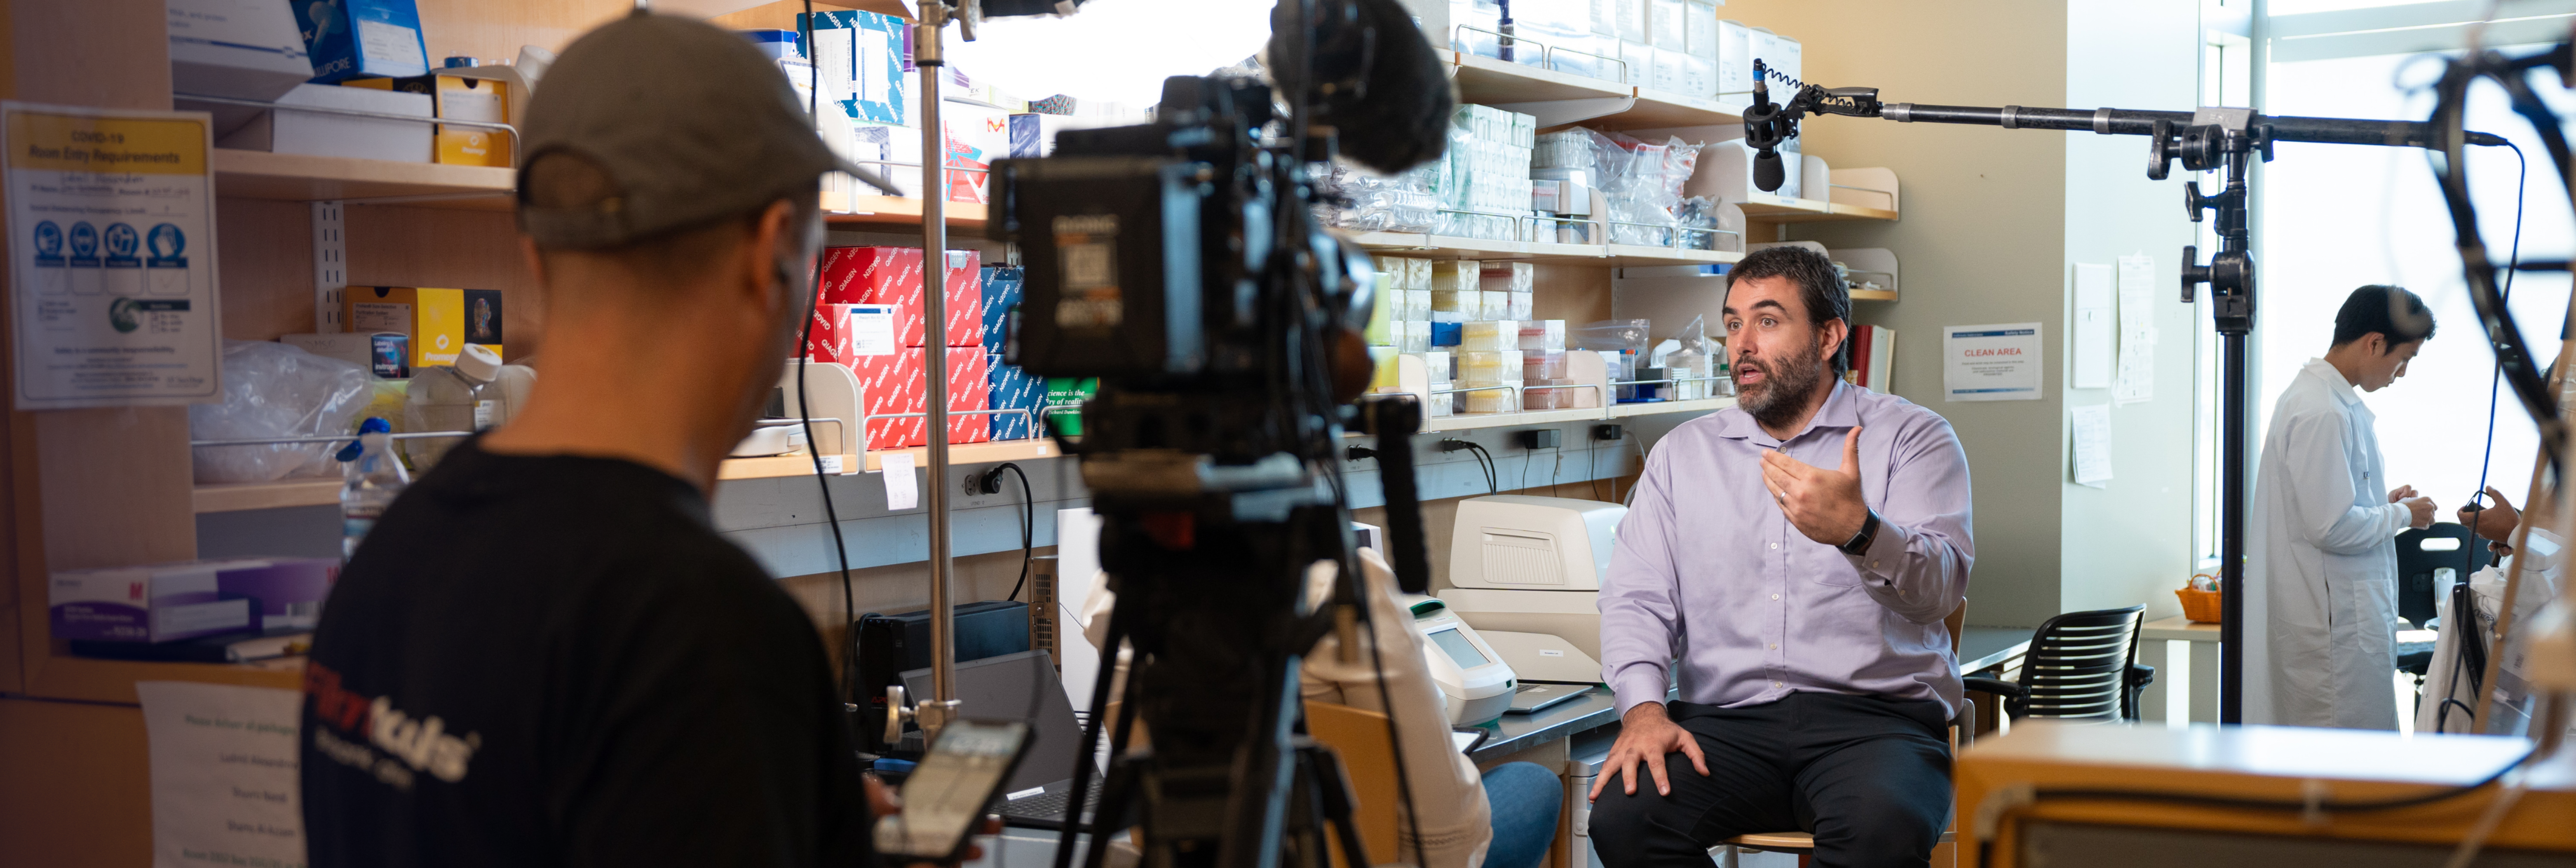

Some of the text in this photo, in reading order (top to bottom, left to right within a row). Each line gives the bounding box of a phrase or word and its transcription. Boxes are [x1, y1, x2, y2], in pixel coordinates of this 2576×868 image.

[825, 12, 843, 29] IAGEN
[882, 15, 896, 40] QIAGEN
[888, 47, 902, 72] QIAGEN
[71, 130, 124, 143] COVID-19
[29, 144, 180, 165] Room Entry Requirements
[823, 249, 841, 272] QIAGEN
[863, 256, 881, 279] QIAGEN
[839, 268, 857, 291] QIAGEN
[897, 264, 911, 286] QIAGEN
[878, 275, 893, 298] QIAGEN
[908, 283, 922, 306] QIAGEN
[954, 280, 967, 302] QIAGEN
[998, 284, 1010, 305] QIAGEN
[965, 299, 977, 320] QIAGEN
[982, 295, 995, 317] QIAGEN
[948, 310, 961, 332] QIAGEN
[993, 312, 1006, 334] QIAGEN
[894, 352, 907, 375] QIAGEN
[967, 350, 979, 373] QIAGEN
[1964, 349, 1994, 357] CLEAN
[875, 364, 889, 388] QIAGEN
[951, 361, 964, 384] QIAGEN
[999, 371, 1011, 392] QIAGEN
[888, 383, 902, 407] QIAGEN
[961, 380, 974, 402] QIAGEN
[1023, 376, 1034, 398] QIAGEN
[1009, 388, 1020, 409] QIAGEN
[1032, 393, 1043, 415] QIAGEN
[911, 416, 924, 440] QIAGEN
[1005, 417, 1016, 439] QIAGEN
